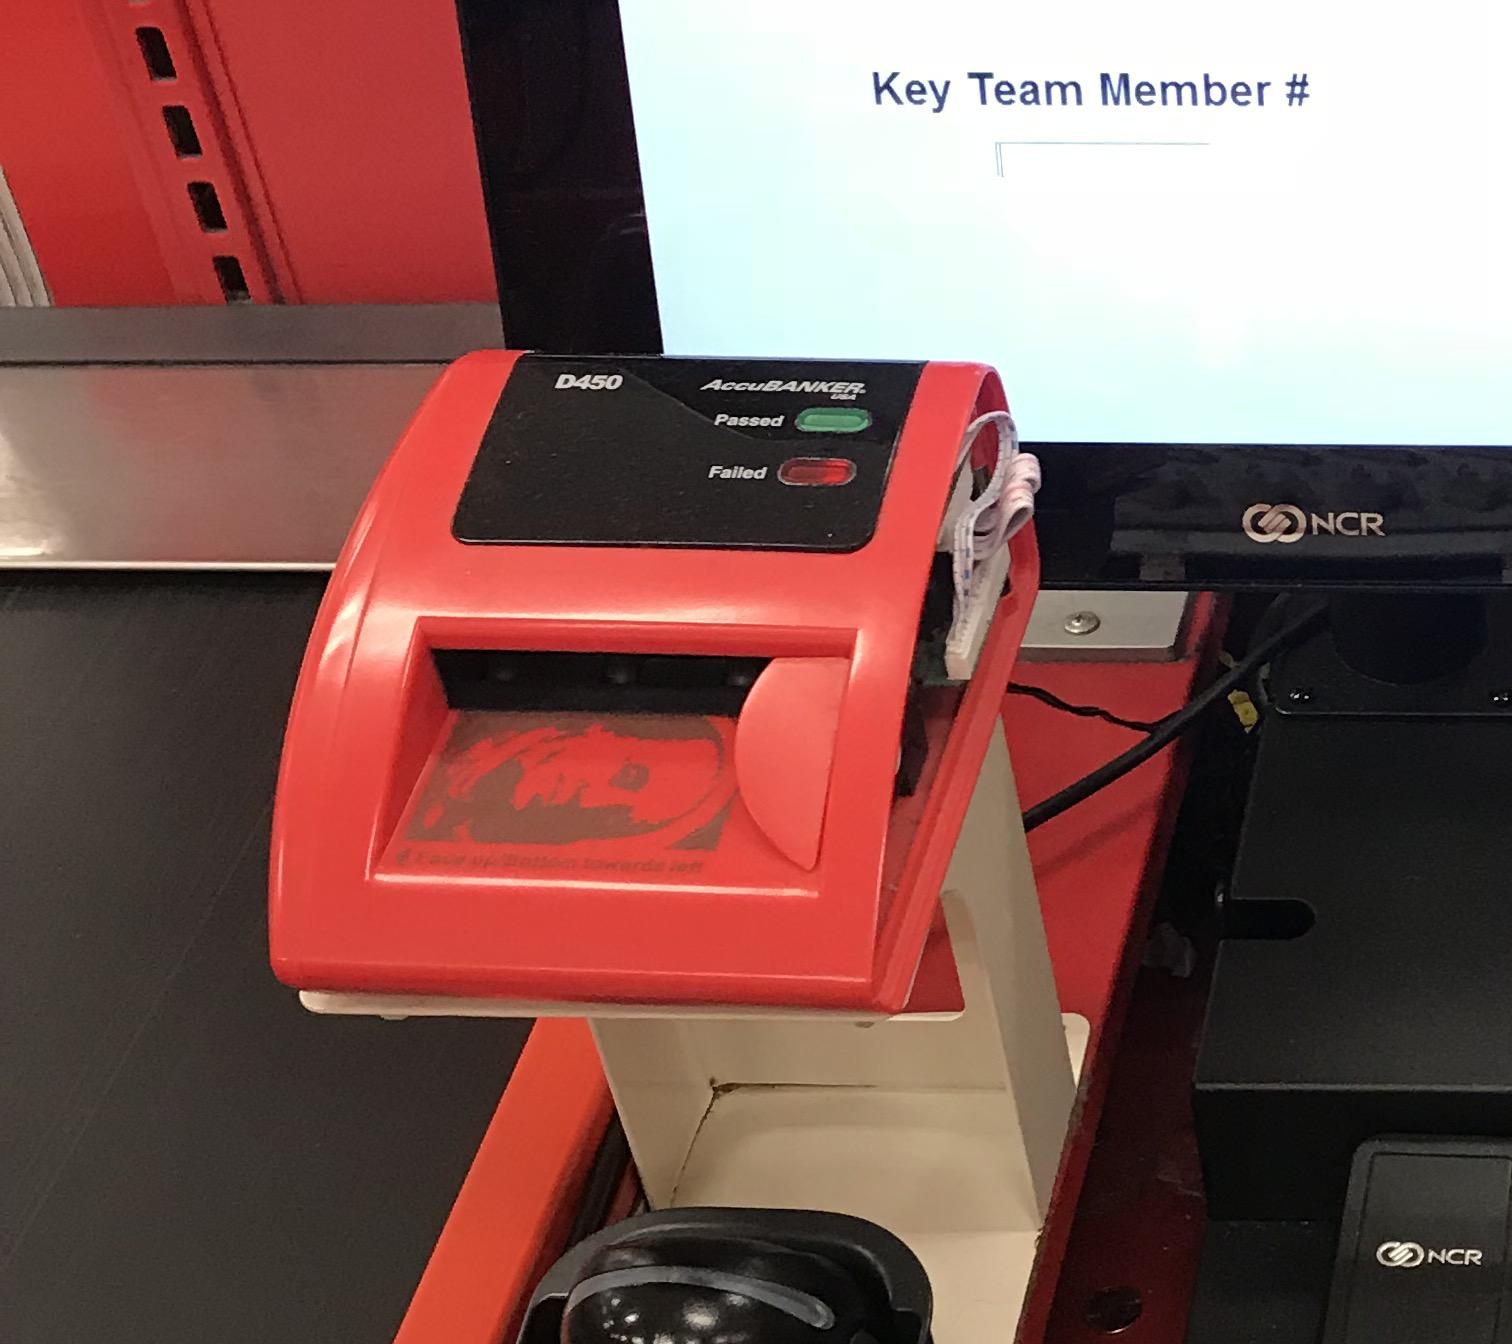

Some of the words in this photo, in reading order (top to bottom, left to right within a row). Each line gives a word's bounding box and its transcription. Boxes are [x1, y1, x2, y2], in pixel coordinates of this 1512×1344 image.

[871, 71, 952, 114] Key
[967, 72, 1084, 106] Team
[1099, 72, 1272, 107] Member
[1284, 73, 1310, 107] #
[554, 373, 623, 391] D450
[713, 413, 786, 427] Passed
[707, 465, 769, 480] Failed
[1311, 511, 1386, 537] NCR
[1427, 1248, 1483, 1265] NCR
